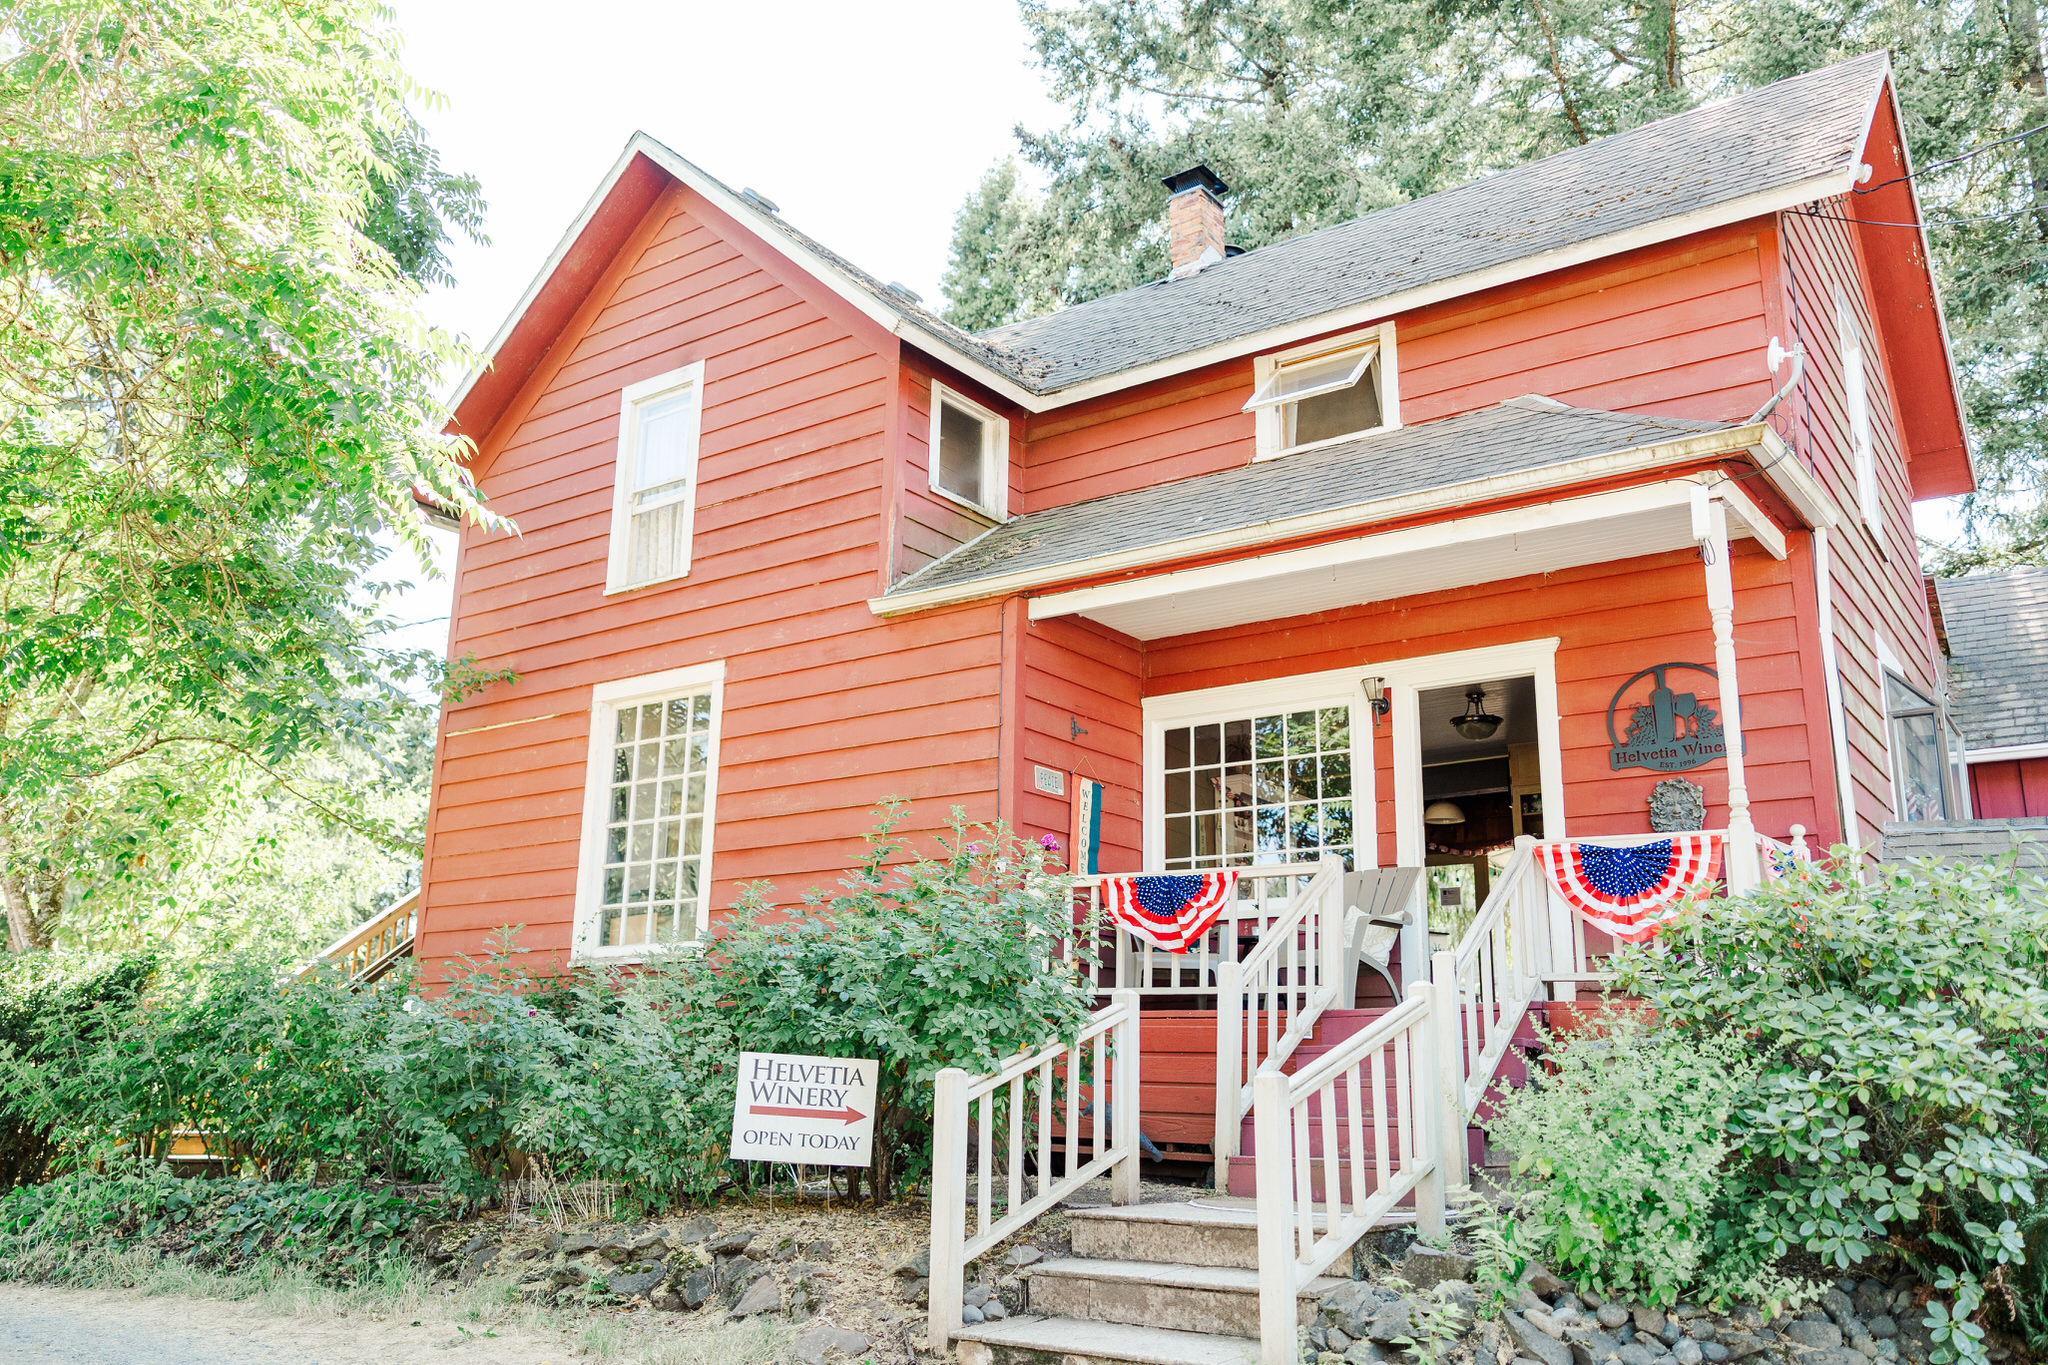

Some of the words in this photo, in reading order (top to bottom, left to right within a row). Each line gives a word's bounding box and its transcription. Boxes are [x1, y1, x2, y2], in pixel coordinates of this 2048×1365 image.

[1616, 747, 1678, 763] Helvetia
[1682, 741, 1727, 755] Winer
[1680, 759, 1697, 767] 1996
[1080, 789, 1091, 872] WELCOME
[753, 1058, 865, 1086] HELVETIA
[750, 1081, 848, 1107] WINERY
[743, 1130, 793, 1146] OPEN
[798, 1133, 860, 1151] TODAY
